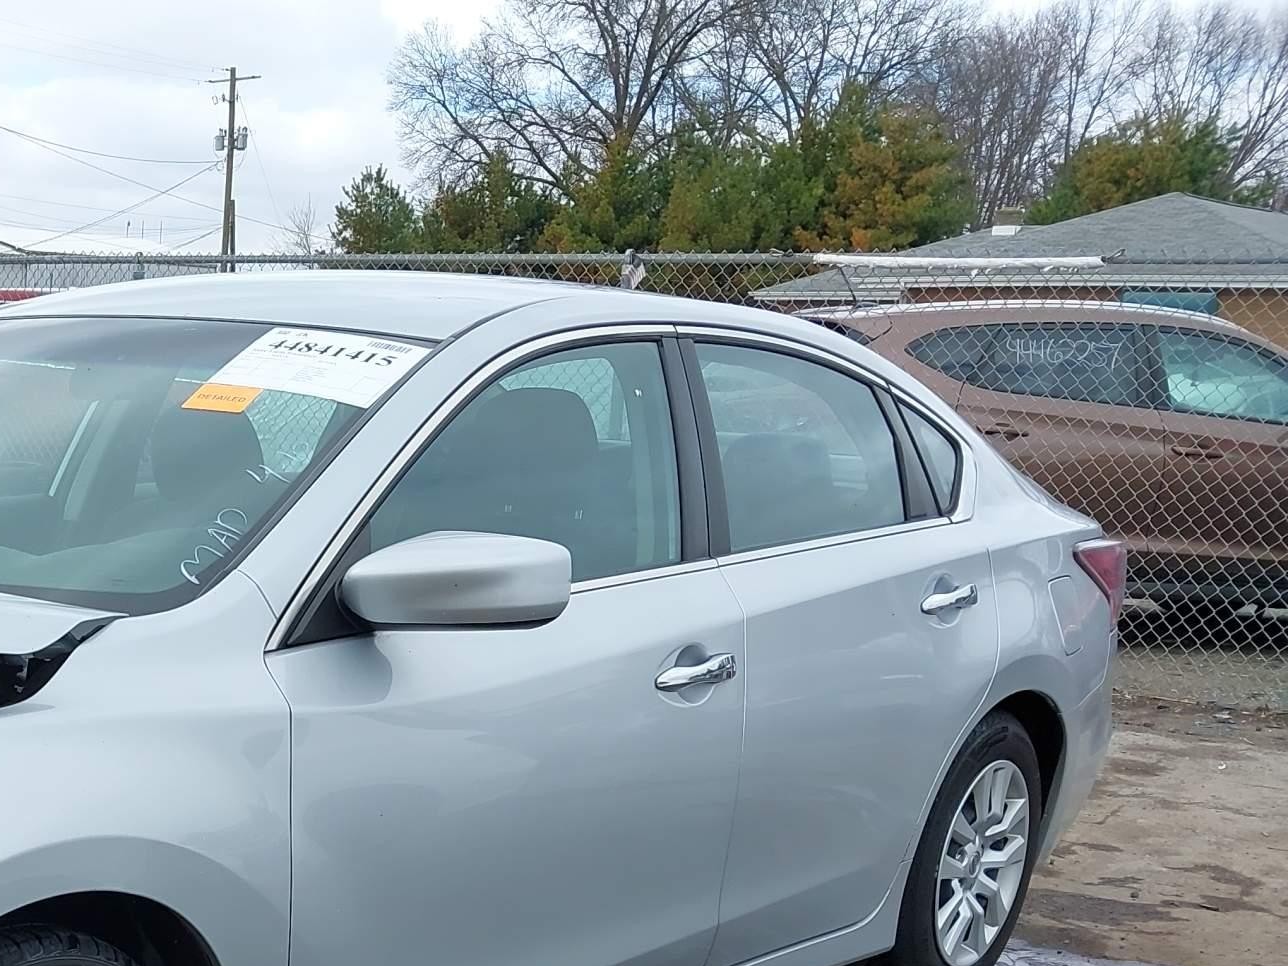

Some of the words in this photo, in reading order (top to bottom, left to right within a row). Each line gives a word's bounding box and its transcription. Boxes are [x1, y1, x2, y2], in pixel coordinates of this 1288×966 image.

[268, 339, 398, 367] 44841415
[197, 393, 247, 403] DETAILED
[180, 508, 248, 585] MAD
